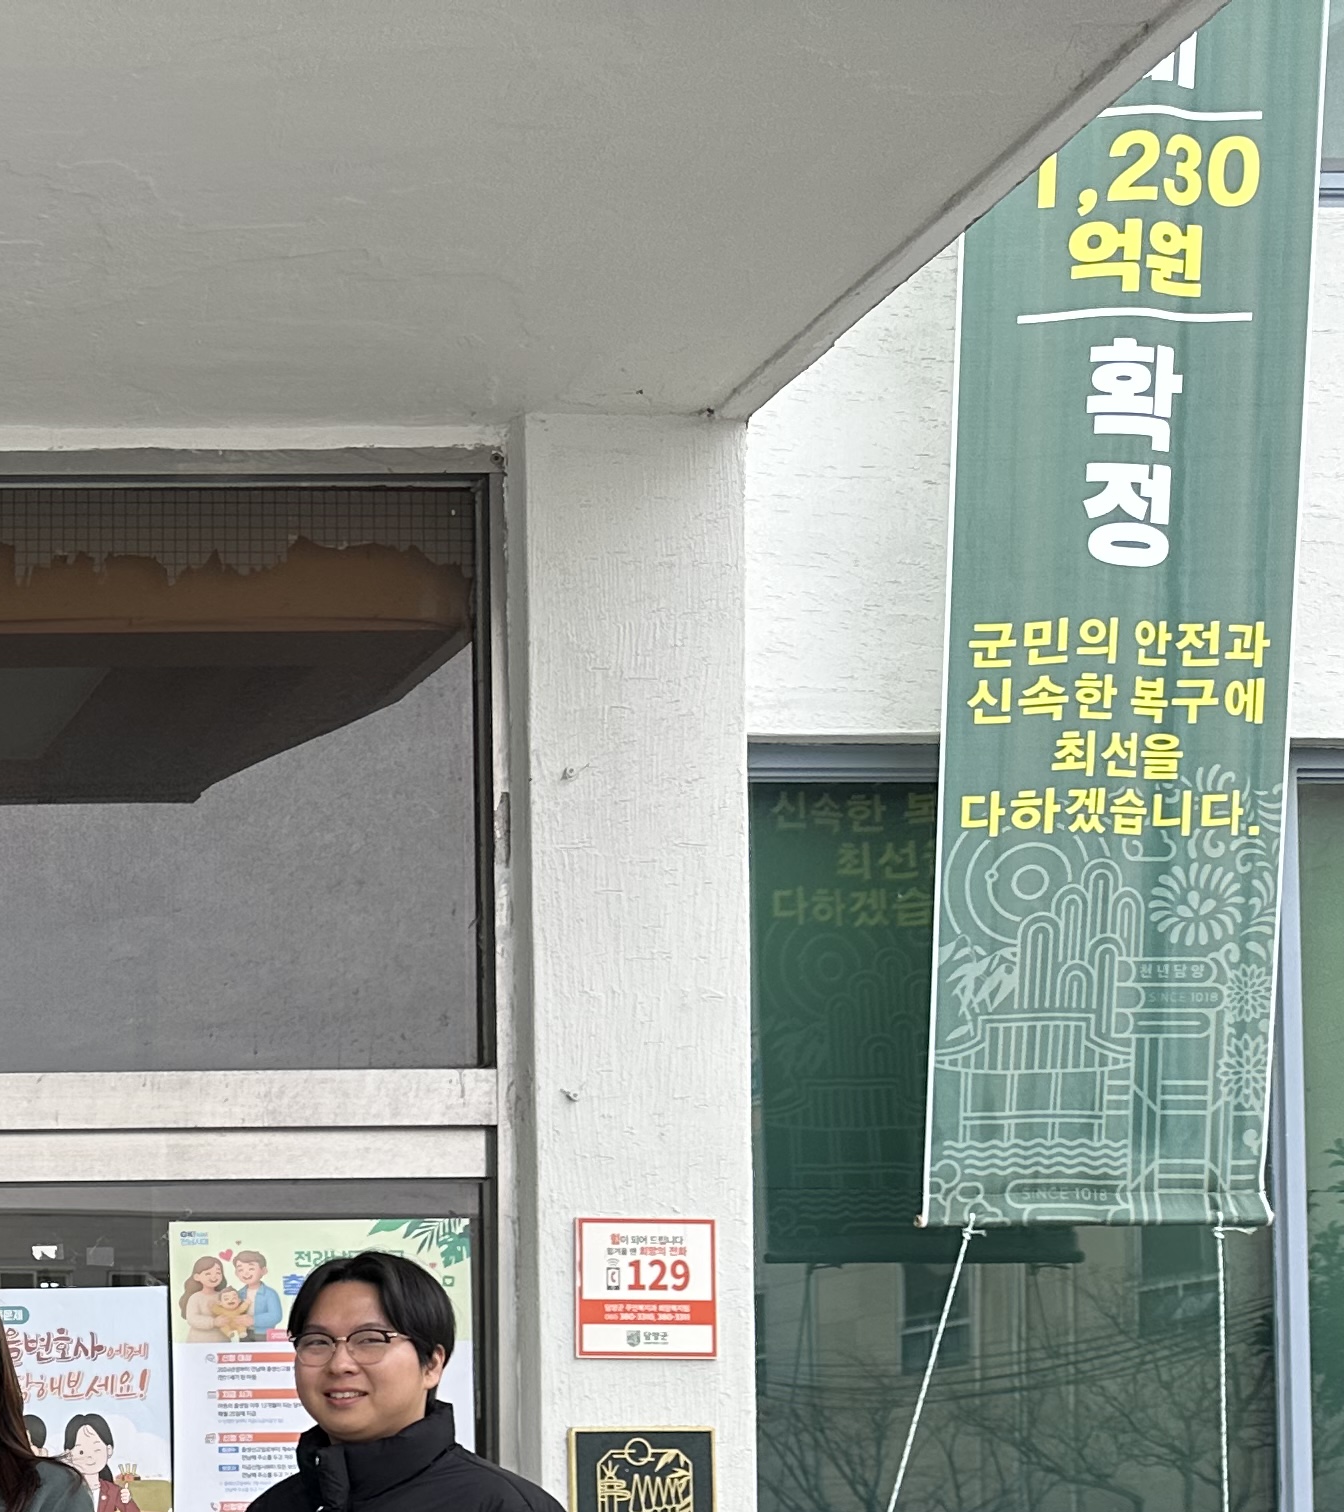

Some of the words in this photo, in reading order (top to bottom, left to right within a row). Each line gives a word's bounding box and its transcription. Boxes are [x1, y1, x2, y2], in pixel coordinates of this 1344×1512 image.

[1067, 219, 1205, 299] 억원
[1083, 337, 1183, 568] 확정
[967, 617, 1119, 668] 군민의
[1133, 618, 1272, 669] 안전과
[966, 673, 1118, 725] 신속한
[1130, 675, 1267, 725] 복구에
[1051, 731, 1184, 780] 최선을
[960, 786, 1262, 837] 다하겠습니다.
[1190, 992, 1219, 1002] 1018
[1020, 1189, 1070, 1200] SINCE
[1075, 1189, 1108, 1201] 1018
[627, 1259, 691, 1291] 129
